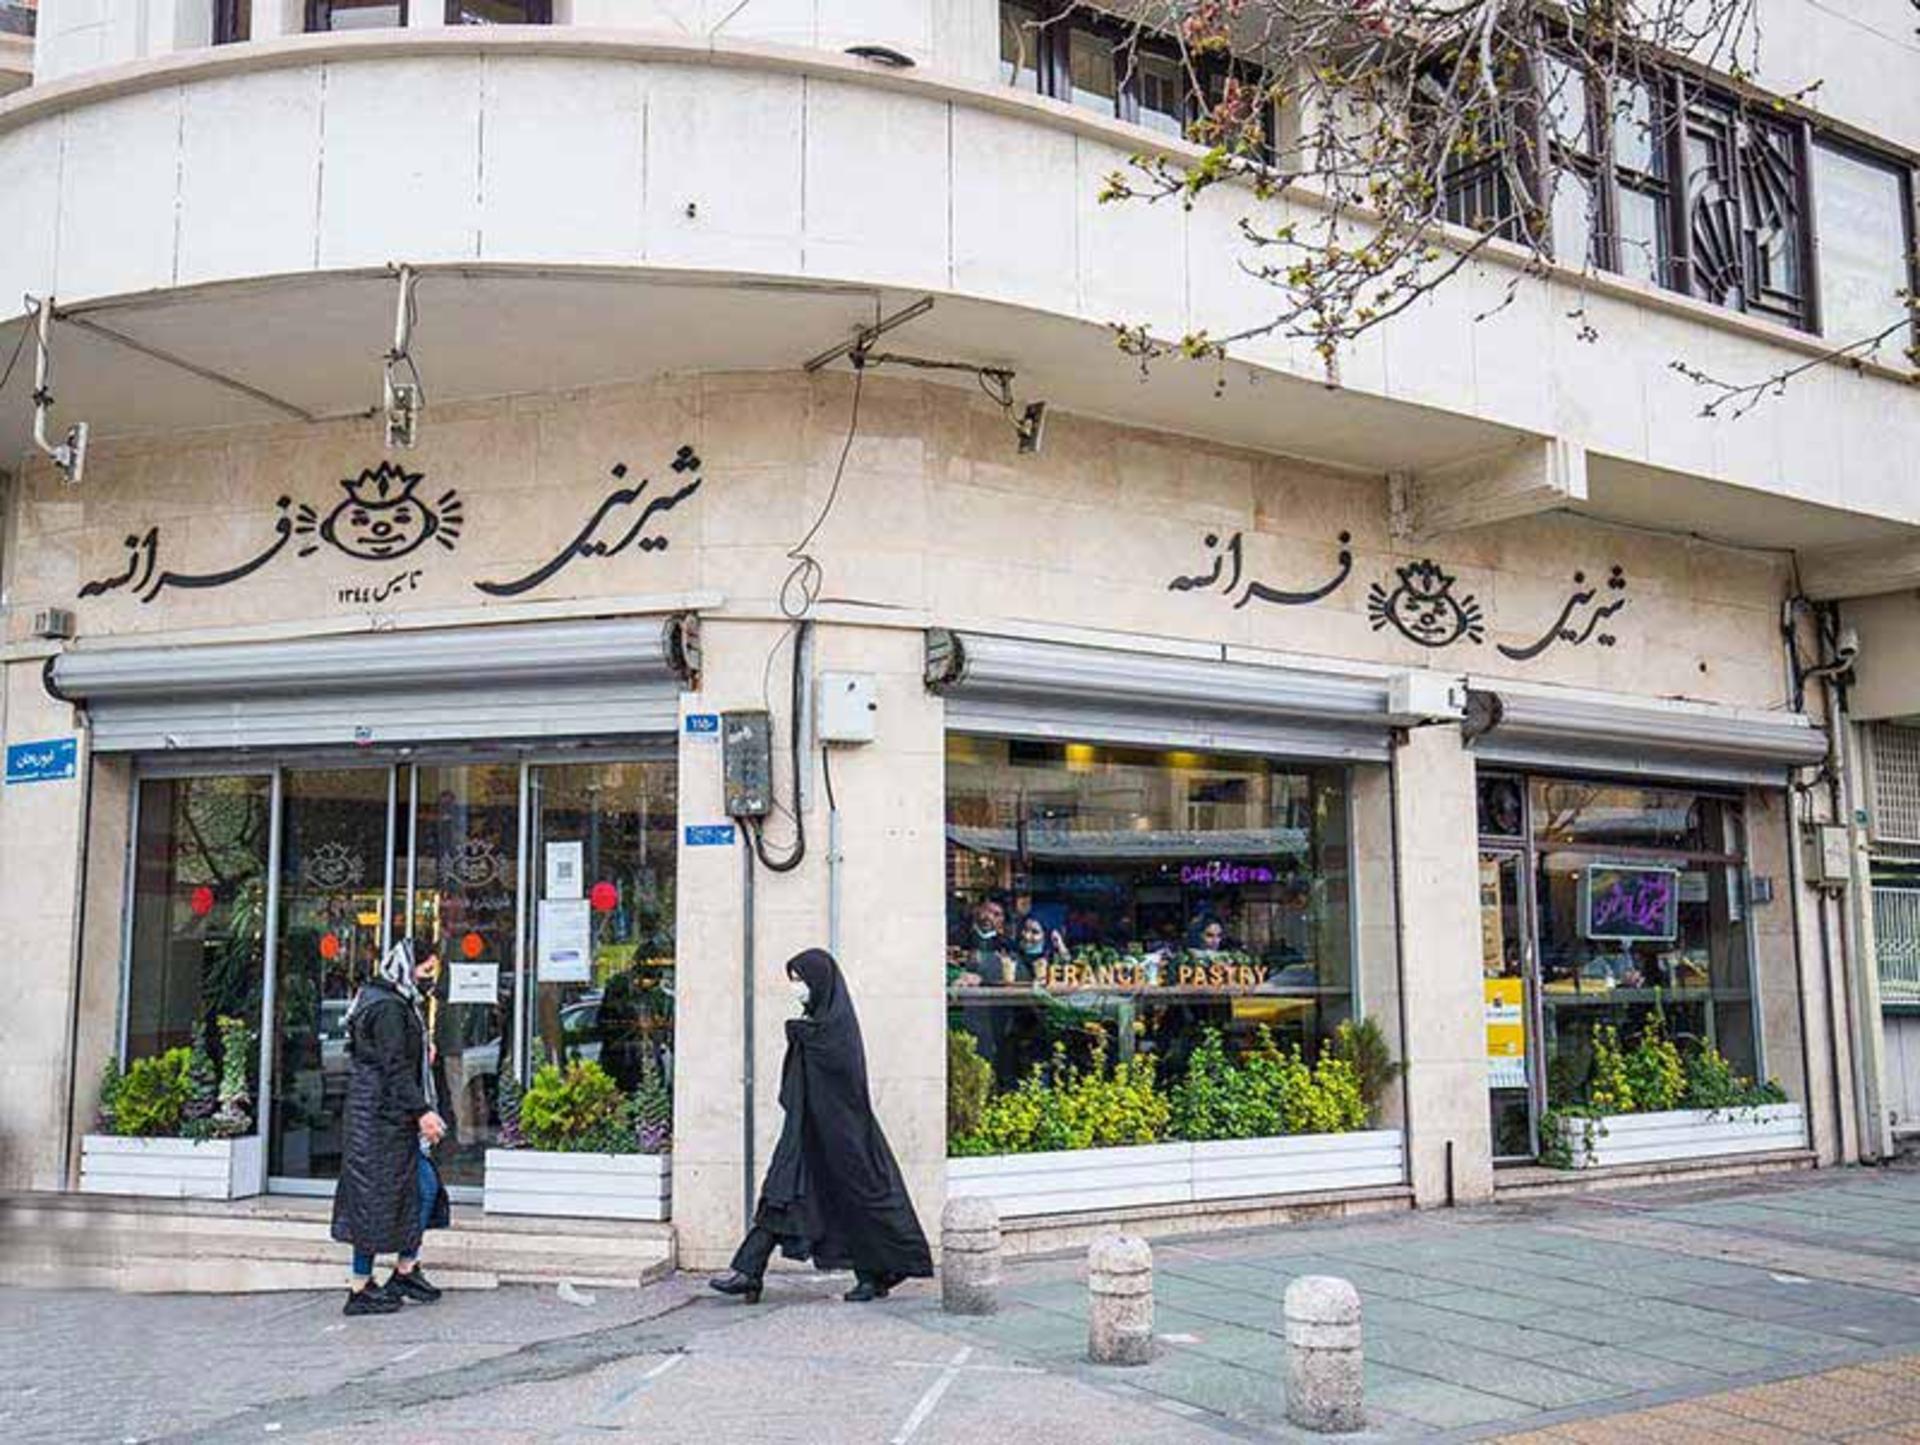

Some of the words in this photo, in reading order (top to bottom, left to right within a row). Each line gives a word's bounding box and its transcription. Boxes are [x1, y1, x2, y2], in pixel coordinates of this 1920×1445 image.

[78, 494, 292, 604] فرانسه
[475, 446, 702, 596] شیرینی
[1168, 530, 1352, 609] فرانسه
[1497, 564, 1631, 661] شیرینی
[1178, 964, 1269, 988] PASTRY
